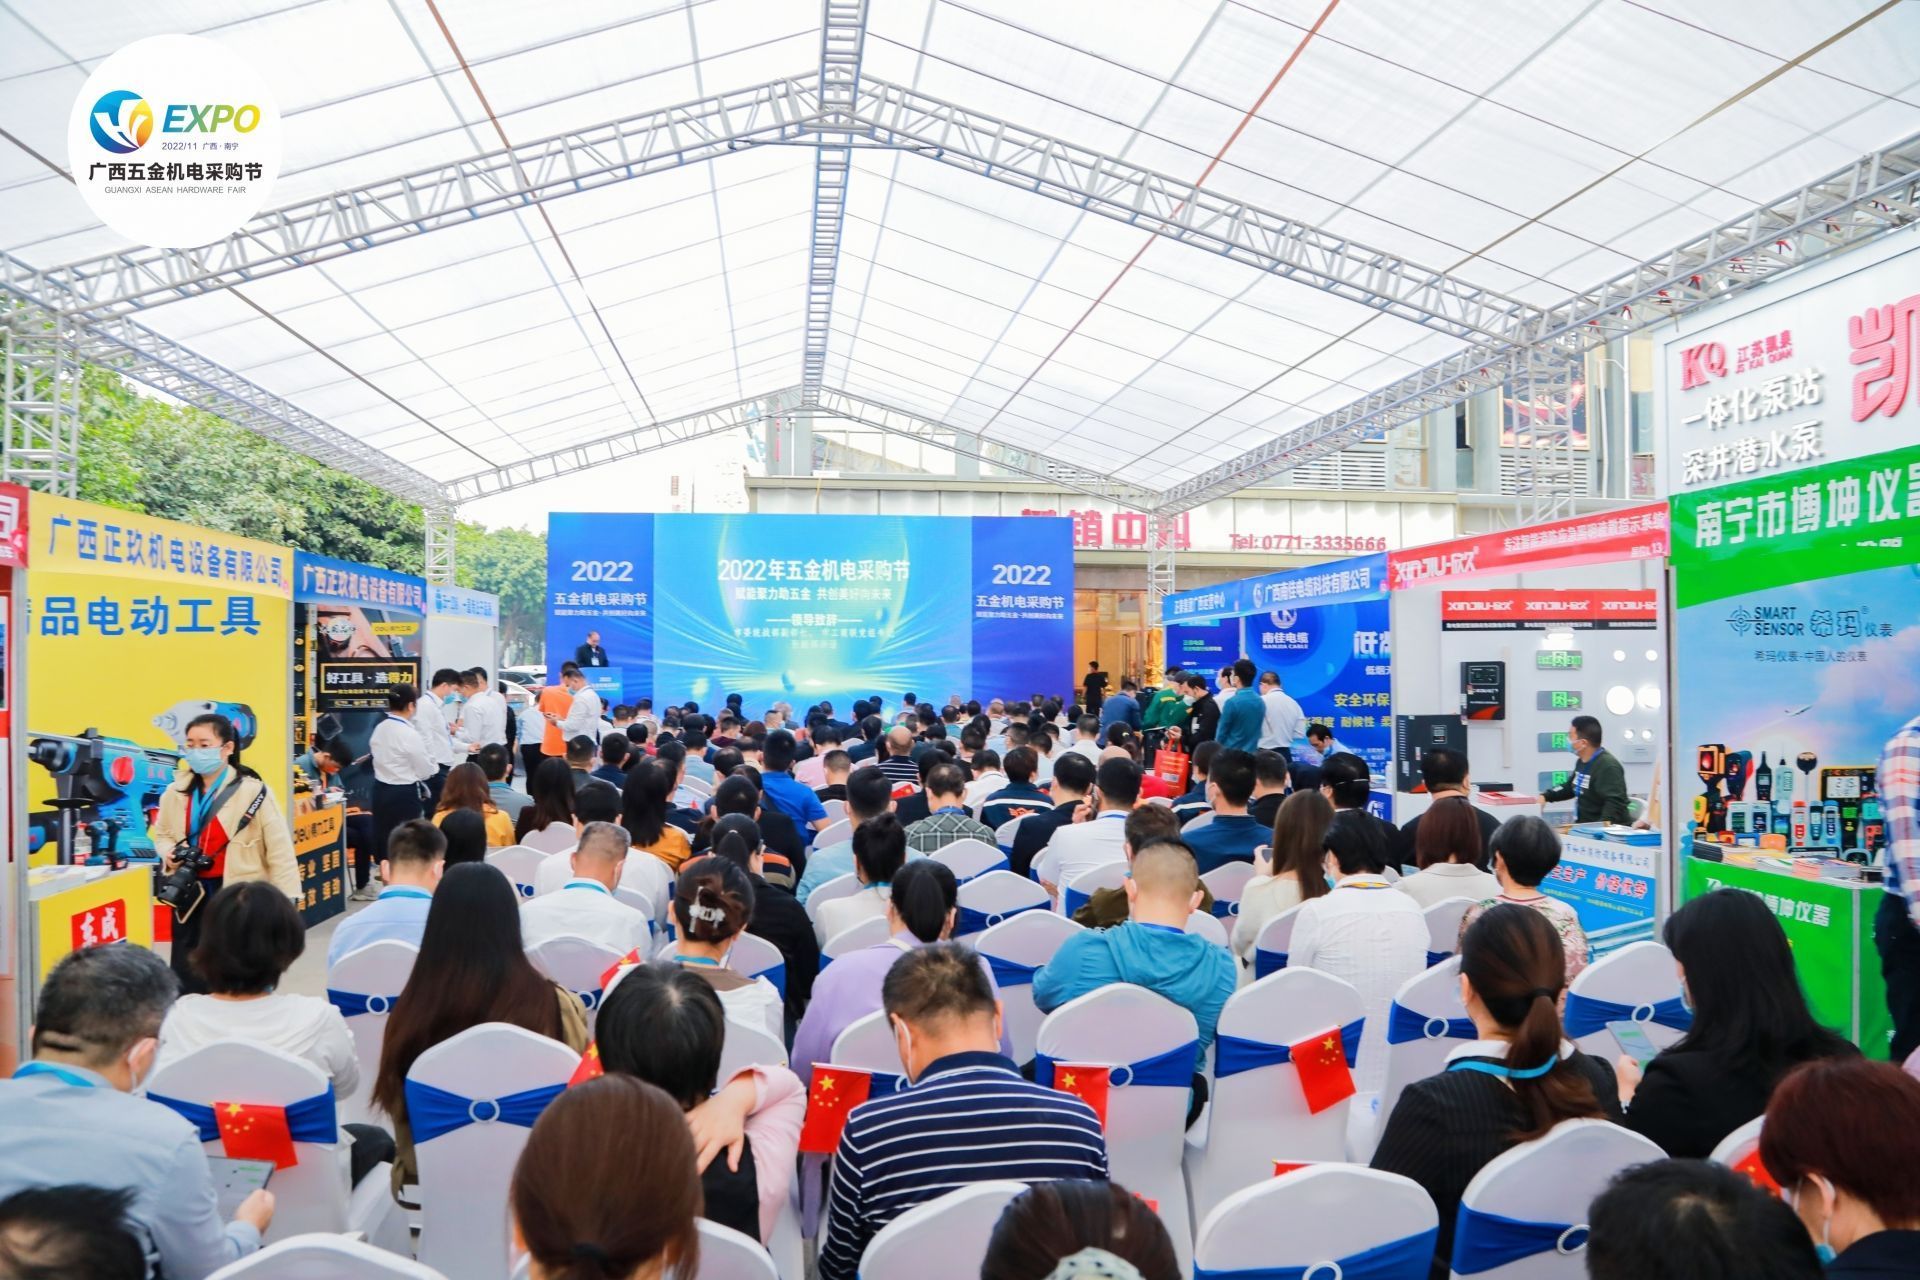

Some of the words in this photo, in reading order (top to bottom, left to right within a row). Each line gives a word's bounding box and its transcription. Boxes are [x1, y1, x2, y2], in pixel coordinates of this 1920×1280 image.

[1680, 342, 1728, 391] KQ
[1681, 369, 1822, 429] 一体化泵站
[1682, 421, 1822, 484] 深井潜水泵
[49, 515, 283, 588] 广西正玖机电设备有限公司
[571, 560, 634, 582] 2022
[718, 558, 910, 582] 2022年五金机电采购节
[992, 564, 1052, 585] 2022
[303, 563, 421, 609] 广西正玖机电设备有限公司
[735, 587, 811, 601] 赋能聚力助五金
[1264, 567, 1370, 603] 广西南佳电缆科技有限公司
[554, 592, 648, 606] 五金机电采购节
[976, 595, 1065, 609] 五金机电采购节
[27, 595, 261, 636] 品电动工具
[1754, 606, 1797, 620] SMART
[1262, 632, 1309, 644] 南佳电缆
[1754, 622, 1805, 636] SENSOR
[1865, 621, 1893, 637] 仪表
[1334, 692, 1390, 707] 安全环保
[249, 793, 265, 815] SONY
